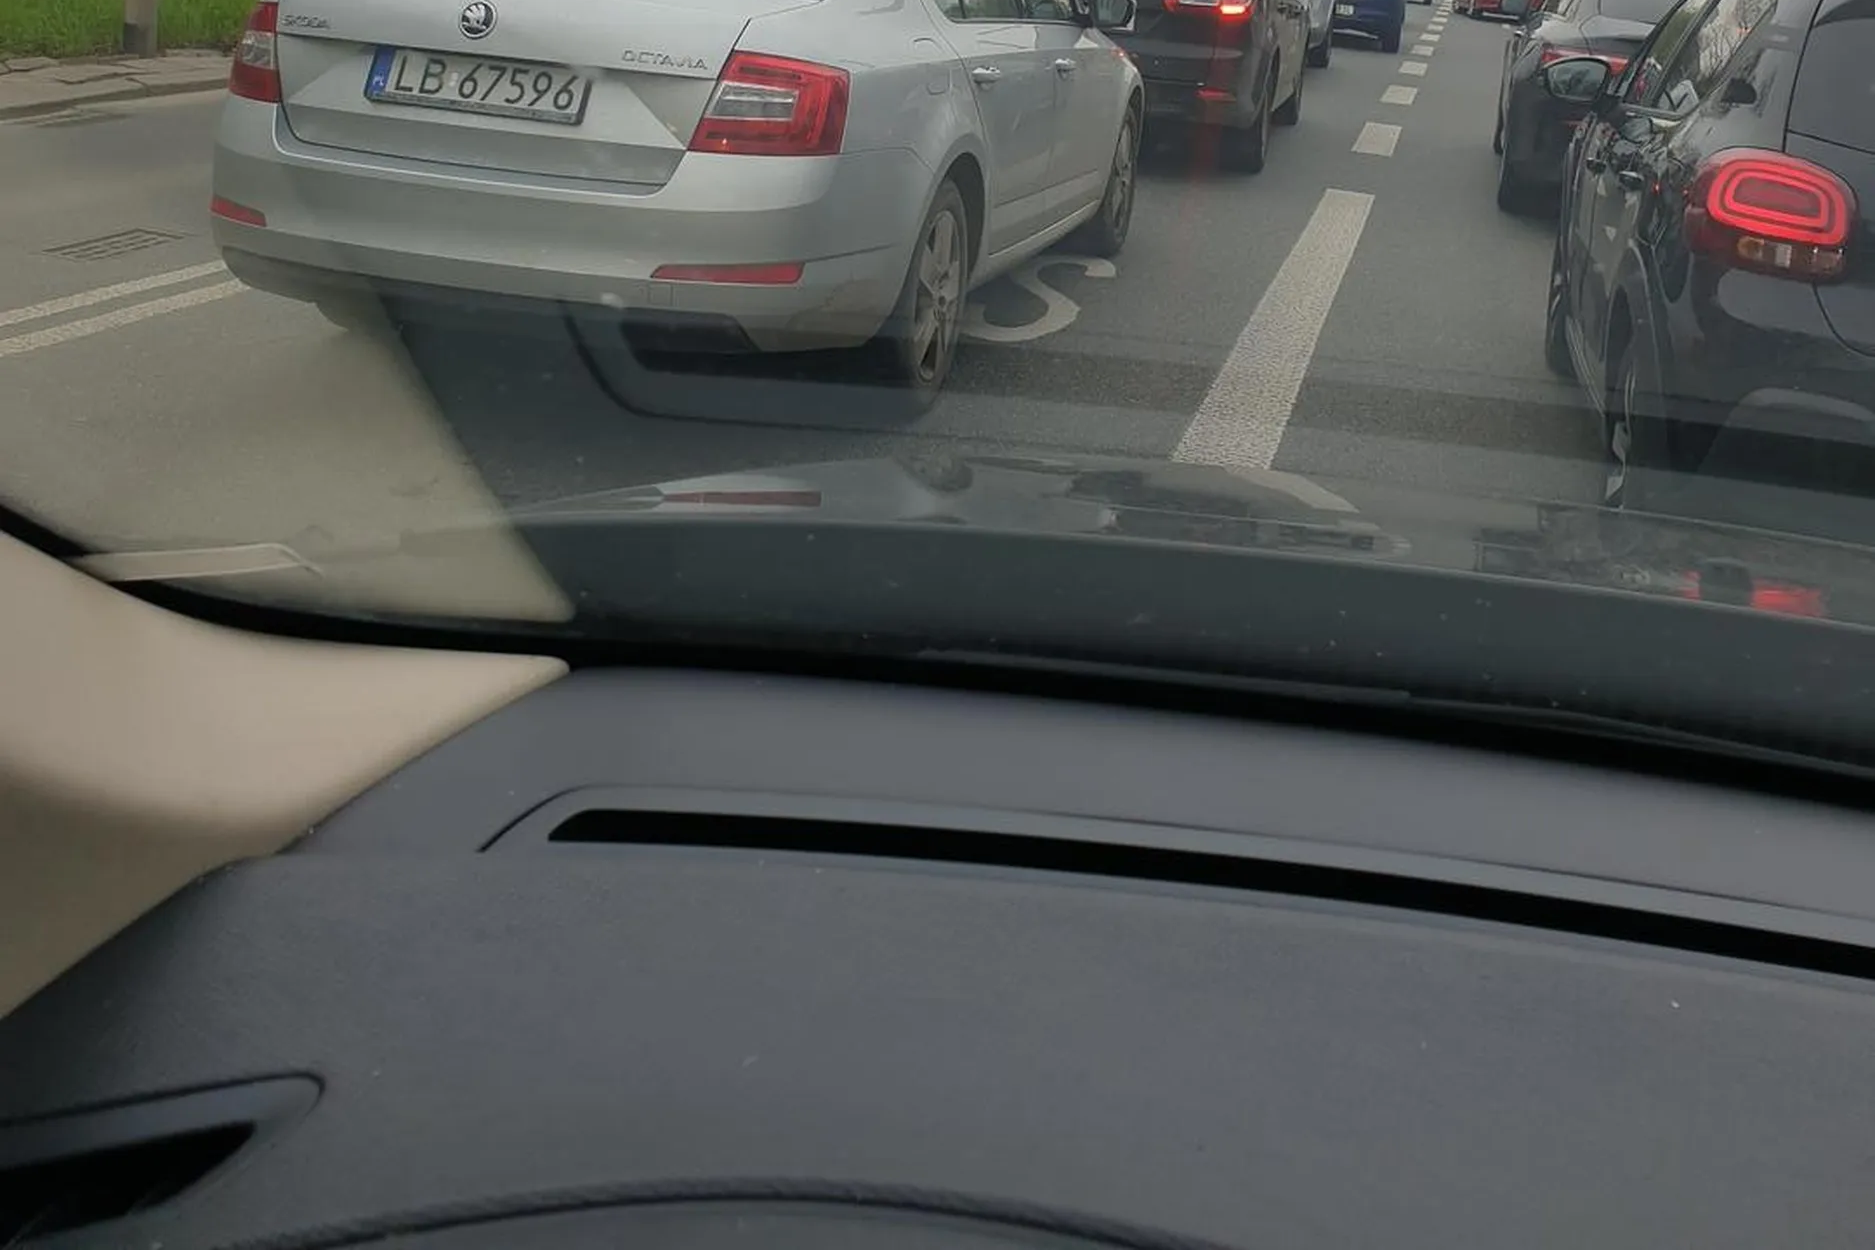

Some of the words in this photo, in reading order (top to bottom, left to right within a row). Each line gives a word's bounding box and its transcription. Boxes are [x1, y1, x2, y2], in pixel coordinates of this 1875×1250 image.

[621, 50, 708, 70] OCTAVIA
[394, 55, 447, 95] LB
[457, 62, 580, 111] 67596
